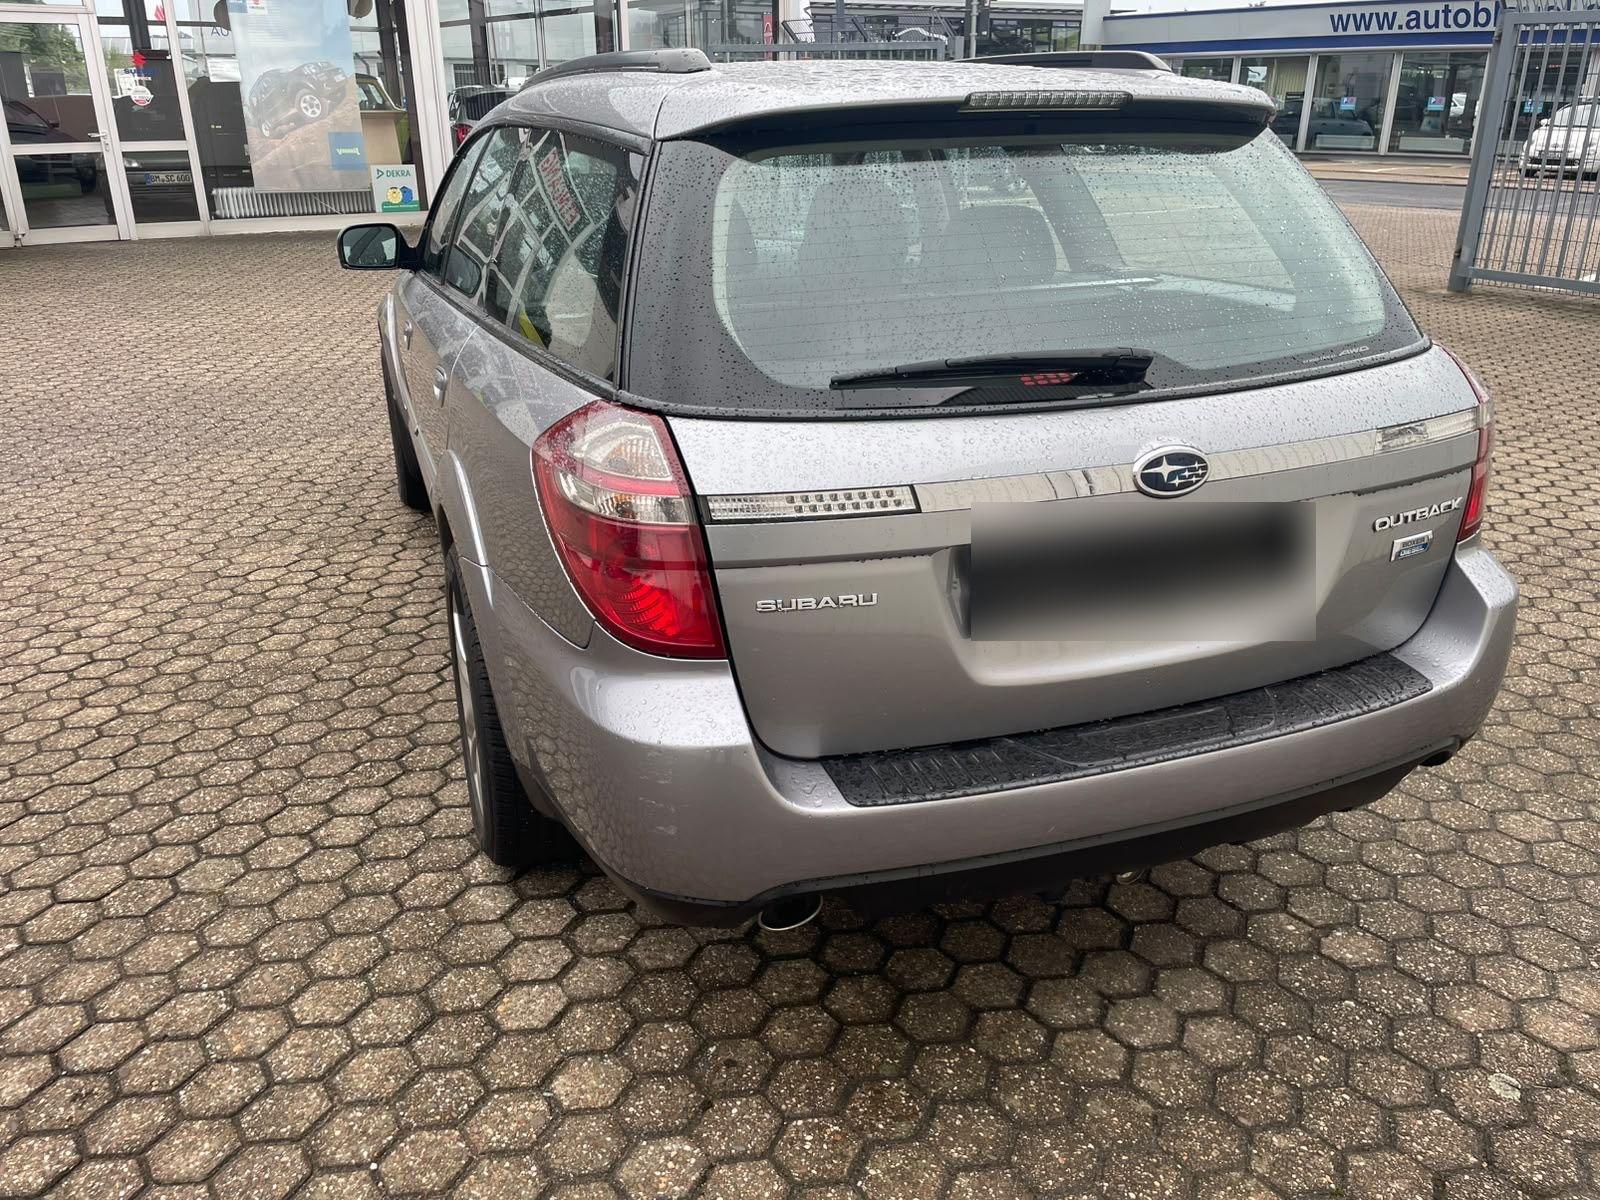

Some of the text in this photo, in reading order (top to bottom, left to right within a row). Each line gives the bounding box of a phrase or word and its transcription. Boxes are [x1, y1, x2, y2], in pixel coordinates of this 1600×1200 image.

[385, 169, 412, 178] DEKRA
[1339, 345, 1370, 357] AWD
[1373, 496, 1463, 532] OUTBACK
[755, 592, 878, 612] SUBARU
